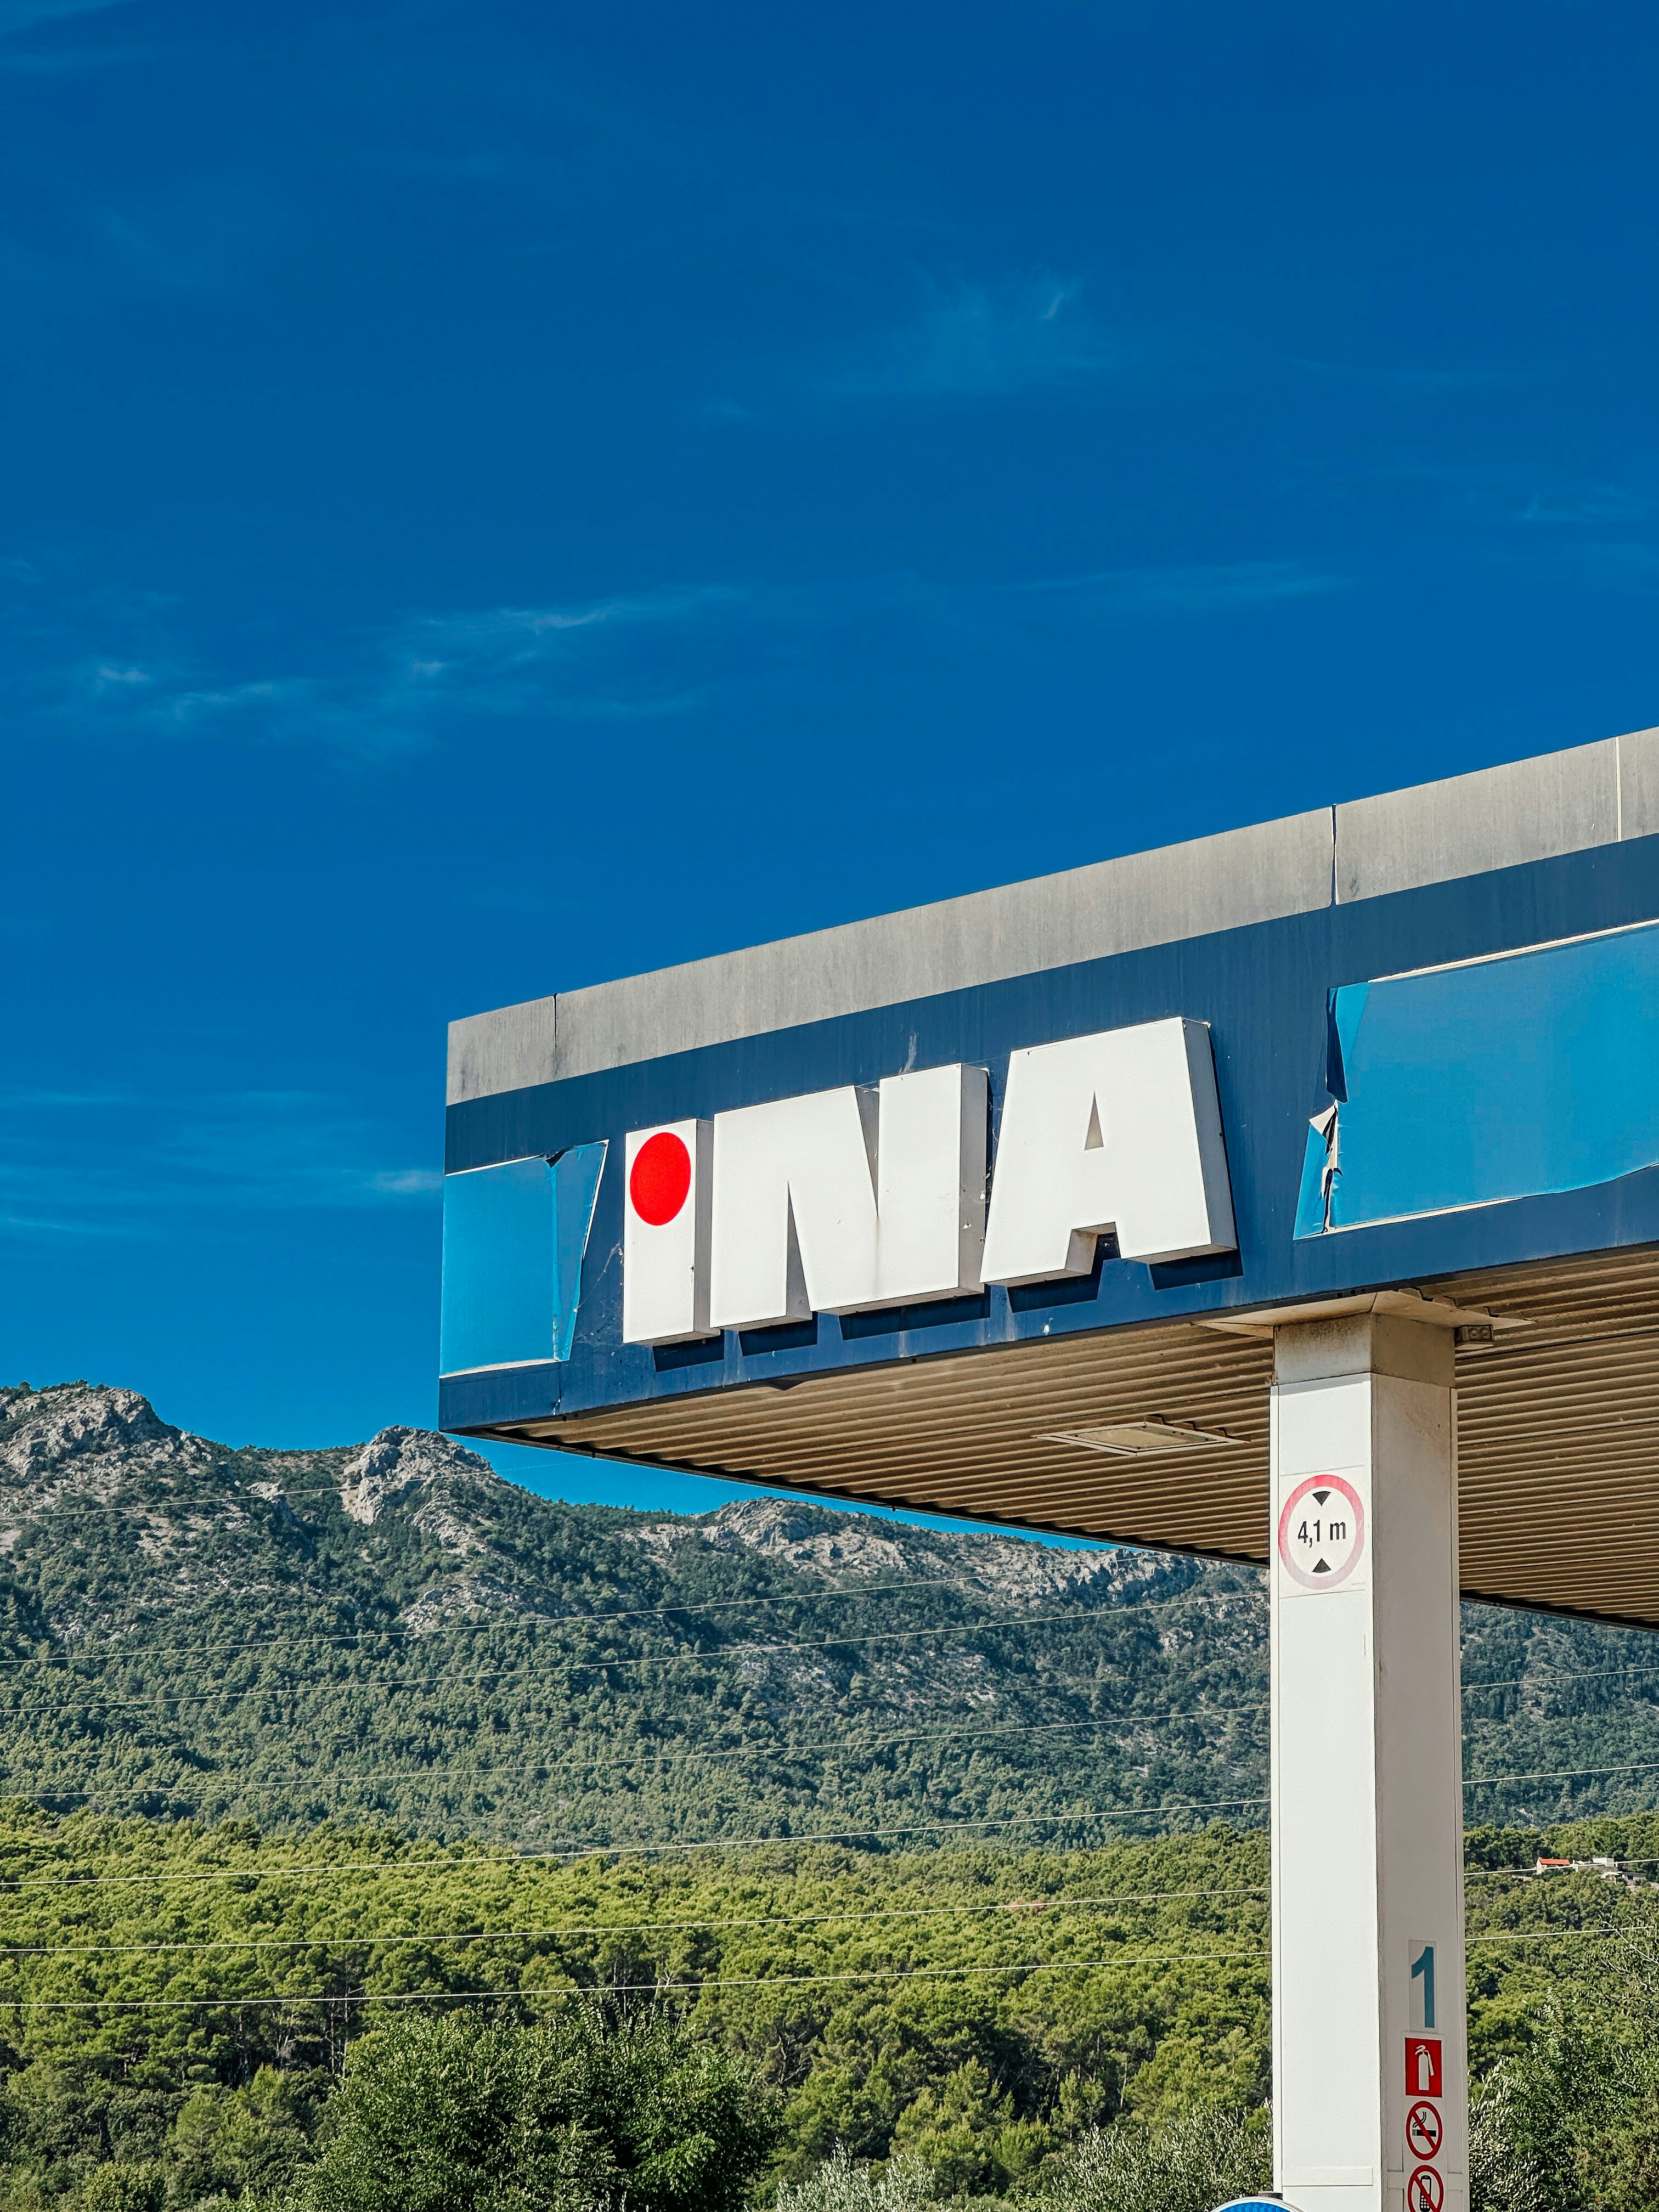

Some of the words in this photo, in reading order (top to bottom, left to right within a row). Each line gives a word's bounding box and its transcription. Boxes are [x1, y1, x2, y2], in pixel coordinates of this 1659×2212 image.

[1297, 1520, 1321, 1548] 4,1
[1330, 1522, 1346, 1541] m
[1411, 1946, 1435, 2028] 1
